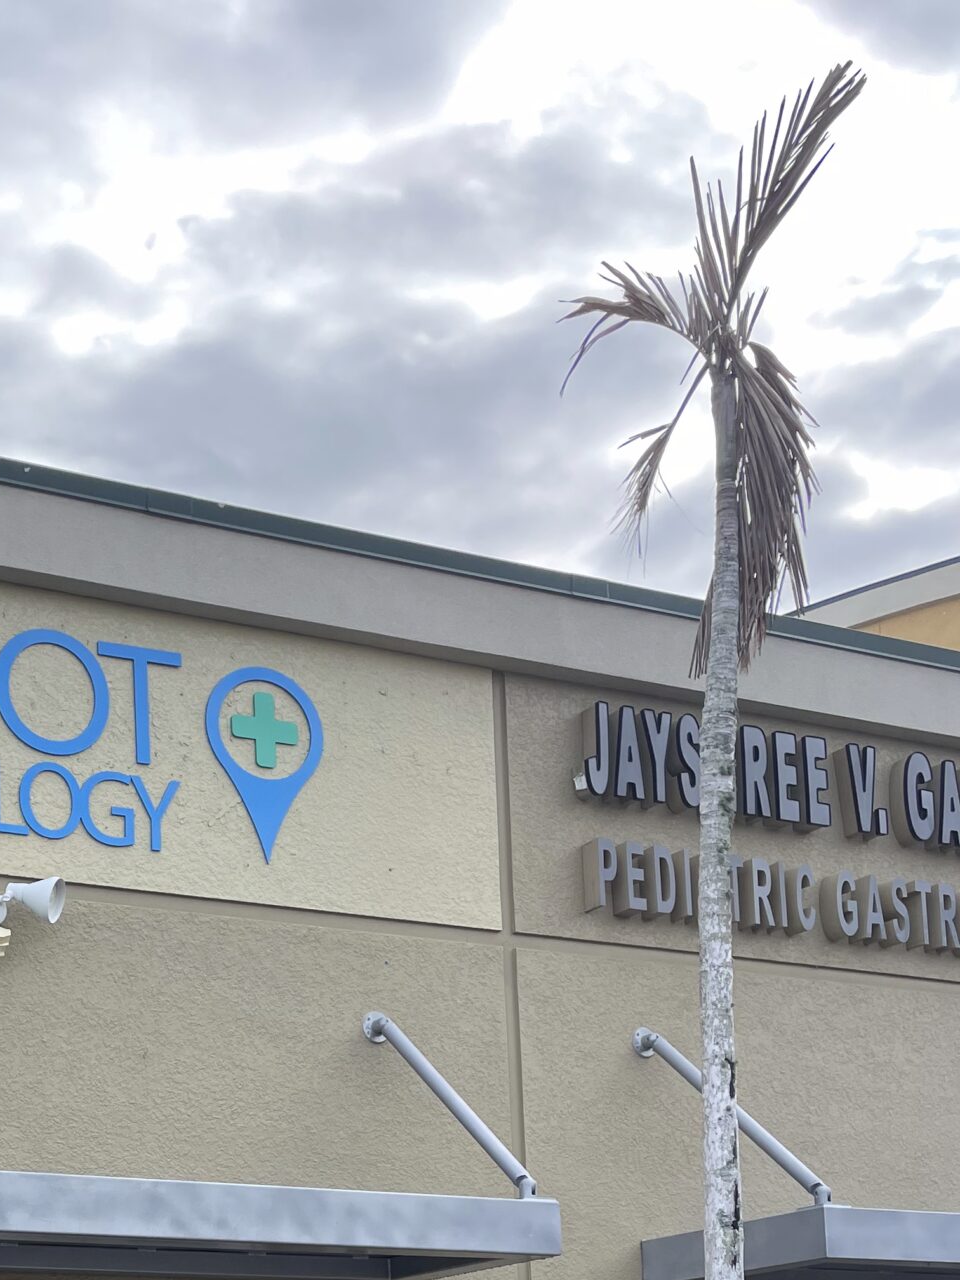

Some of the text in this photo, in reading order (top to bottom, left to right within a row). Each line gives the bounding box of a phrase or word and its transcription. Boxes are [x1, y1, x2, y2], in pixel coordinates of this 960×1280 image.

[584, 700, 831, 827] JAYSREE
[846, 742, 888, 836] V.
[597, 837, 816, 932] PEDITRIC
